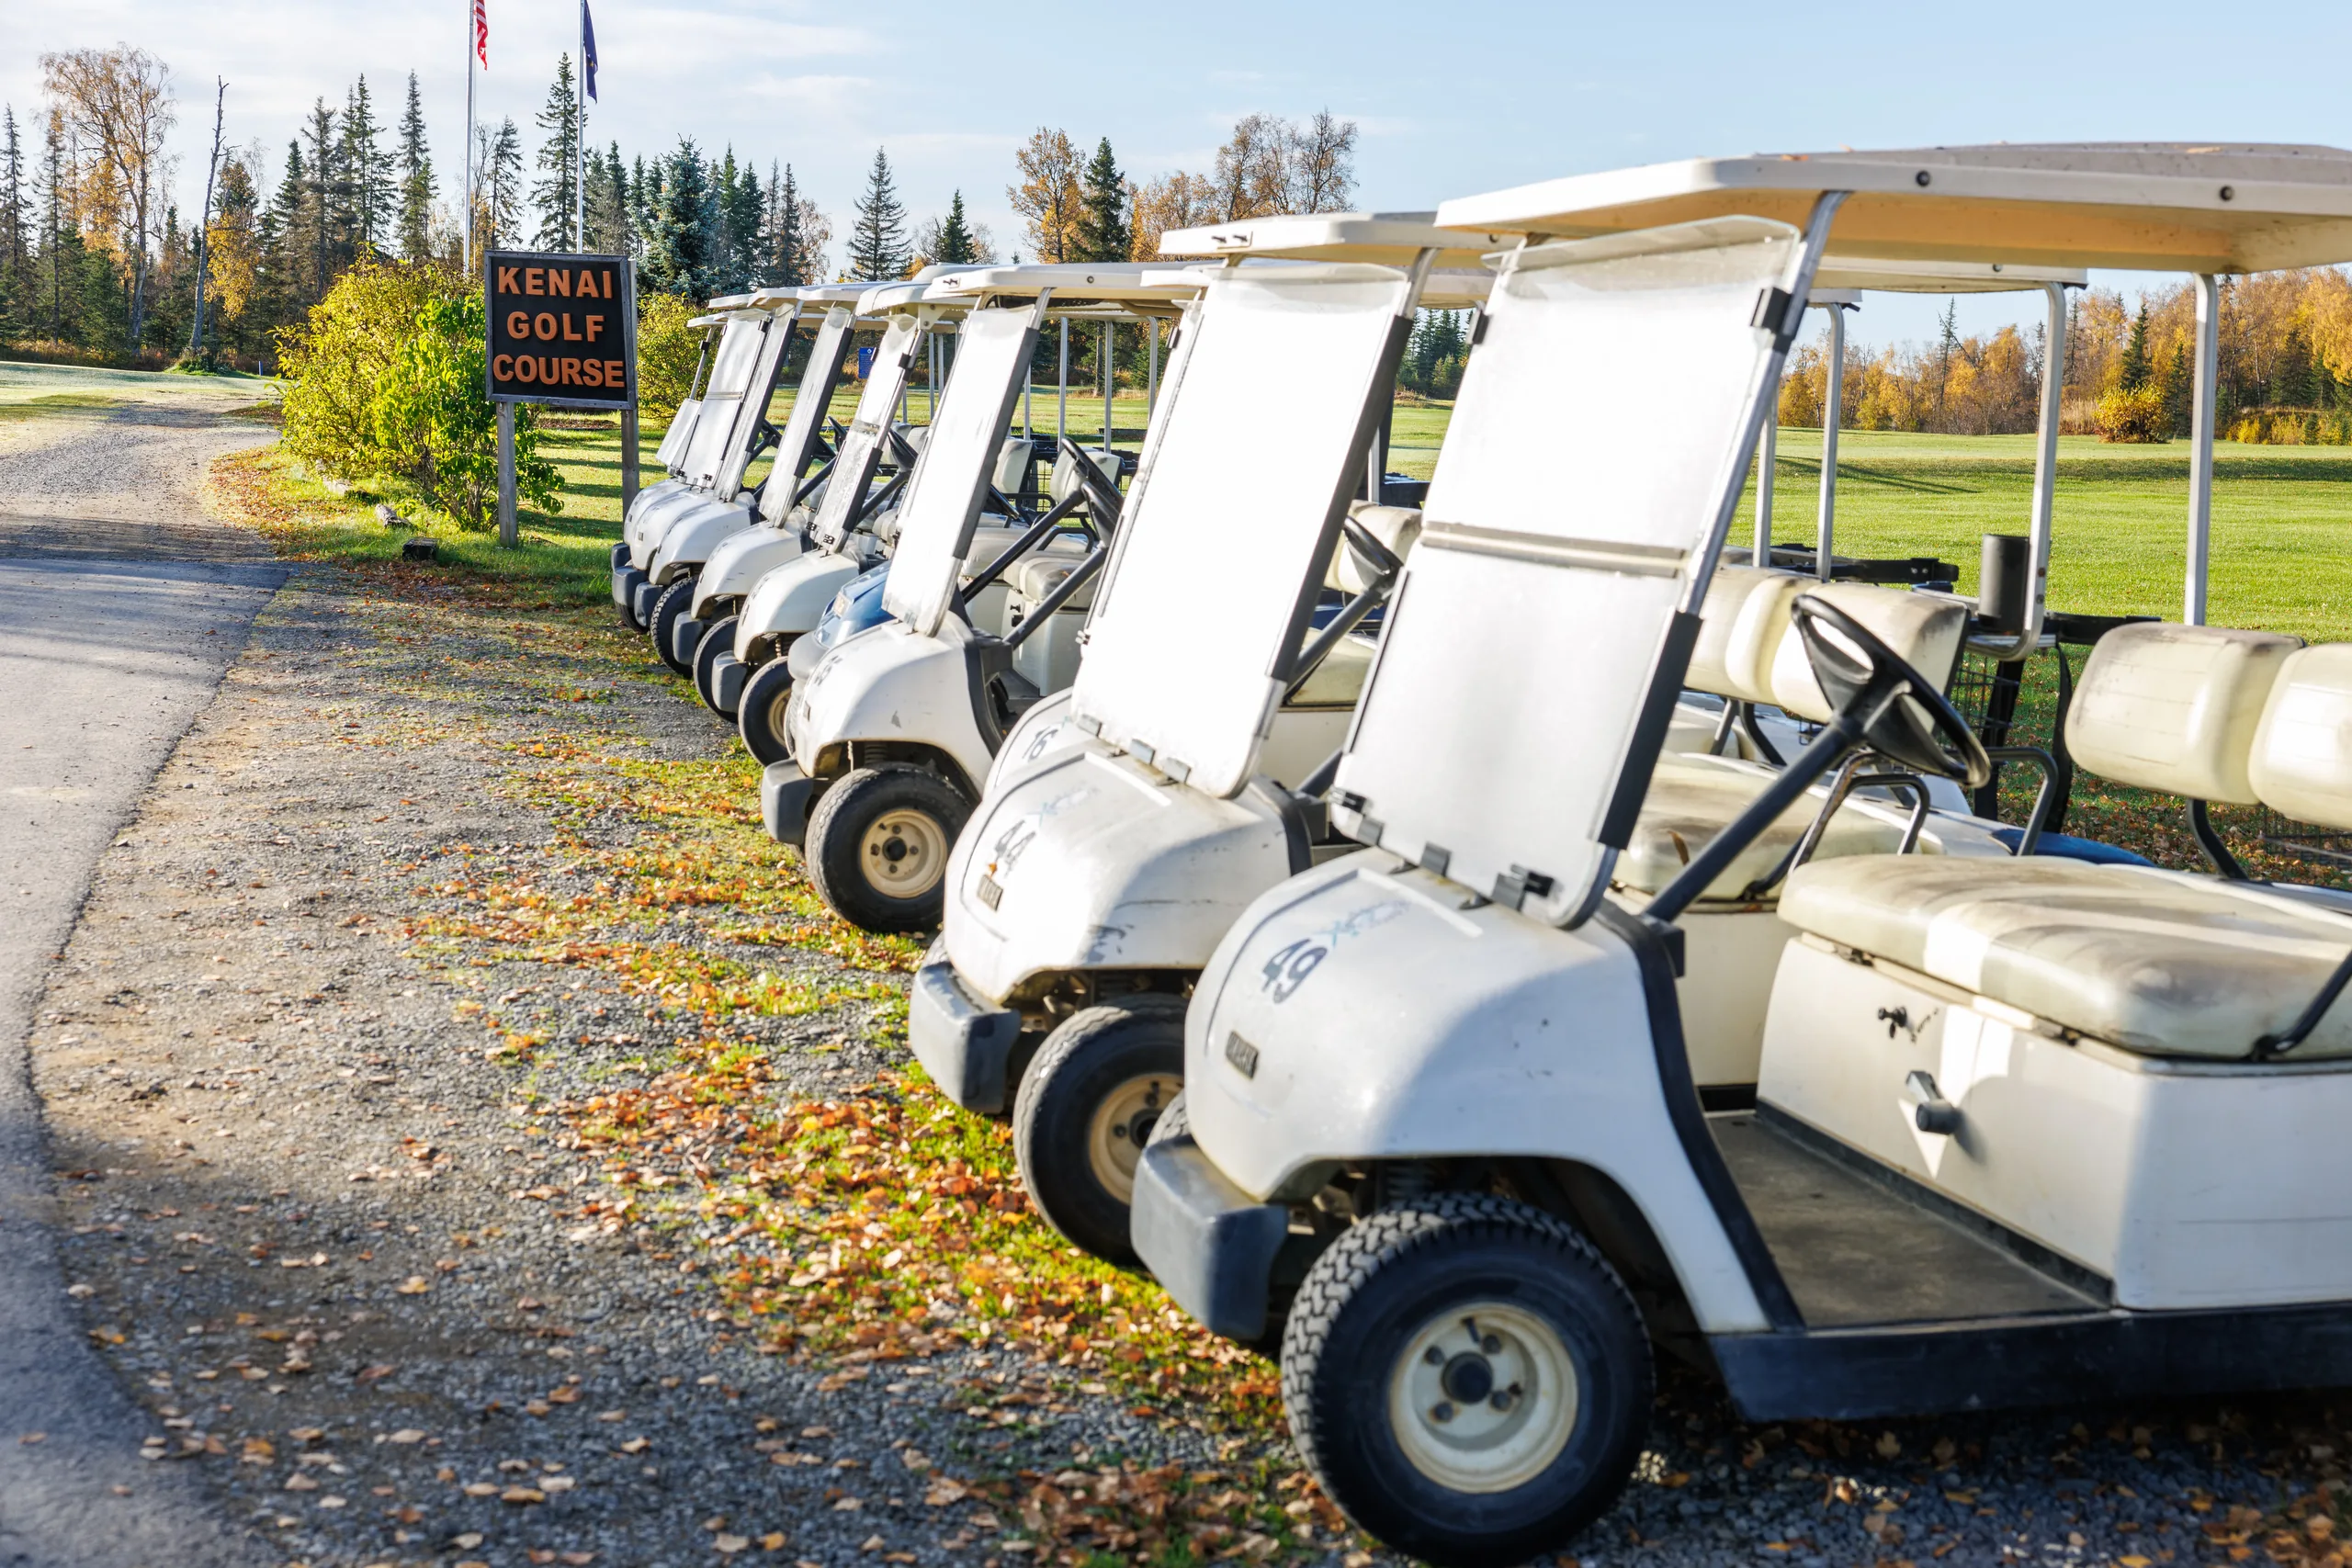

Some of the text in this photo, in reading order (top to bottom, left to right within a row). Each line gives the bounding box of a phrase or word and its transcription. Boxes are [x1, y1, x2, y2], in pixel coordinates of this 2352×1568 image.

[498, 266, 613, 299] KENAI
[507, 311, 605, 342] GOLF
[492, 354, 625, 388] COURSE
[1261, 938, 1329, 1004] 49
